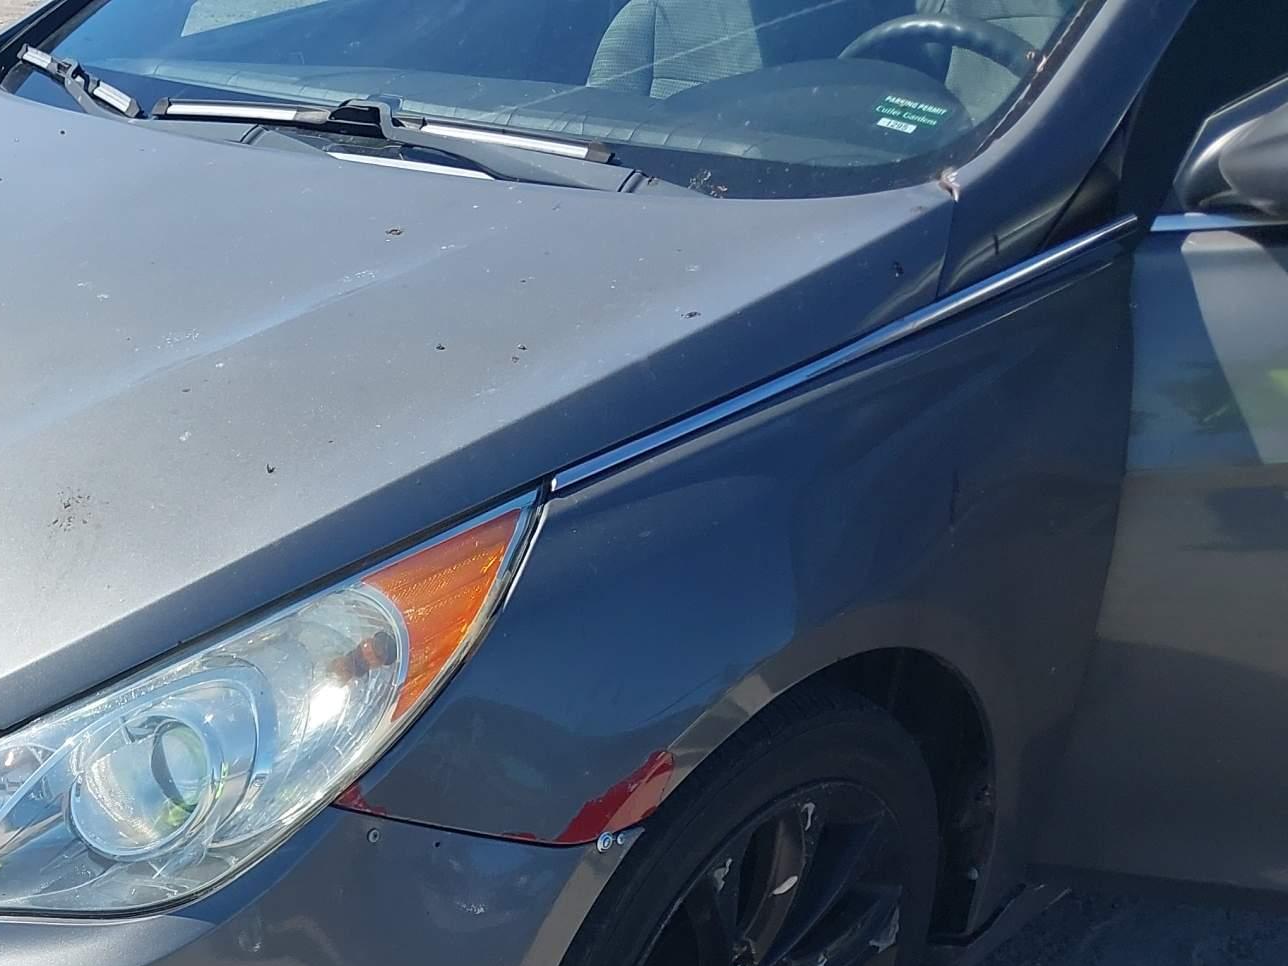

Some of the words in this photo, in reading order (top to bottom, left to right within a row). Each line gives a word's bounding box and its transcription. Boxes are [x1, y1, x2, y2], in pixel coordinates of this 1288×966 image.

[885, 96, 919, 109] PARKING
[917, 104, 947, 115] PERMIT
[902, 111, 937, 125] Gardens
